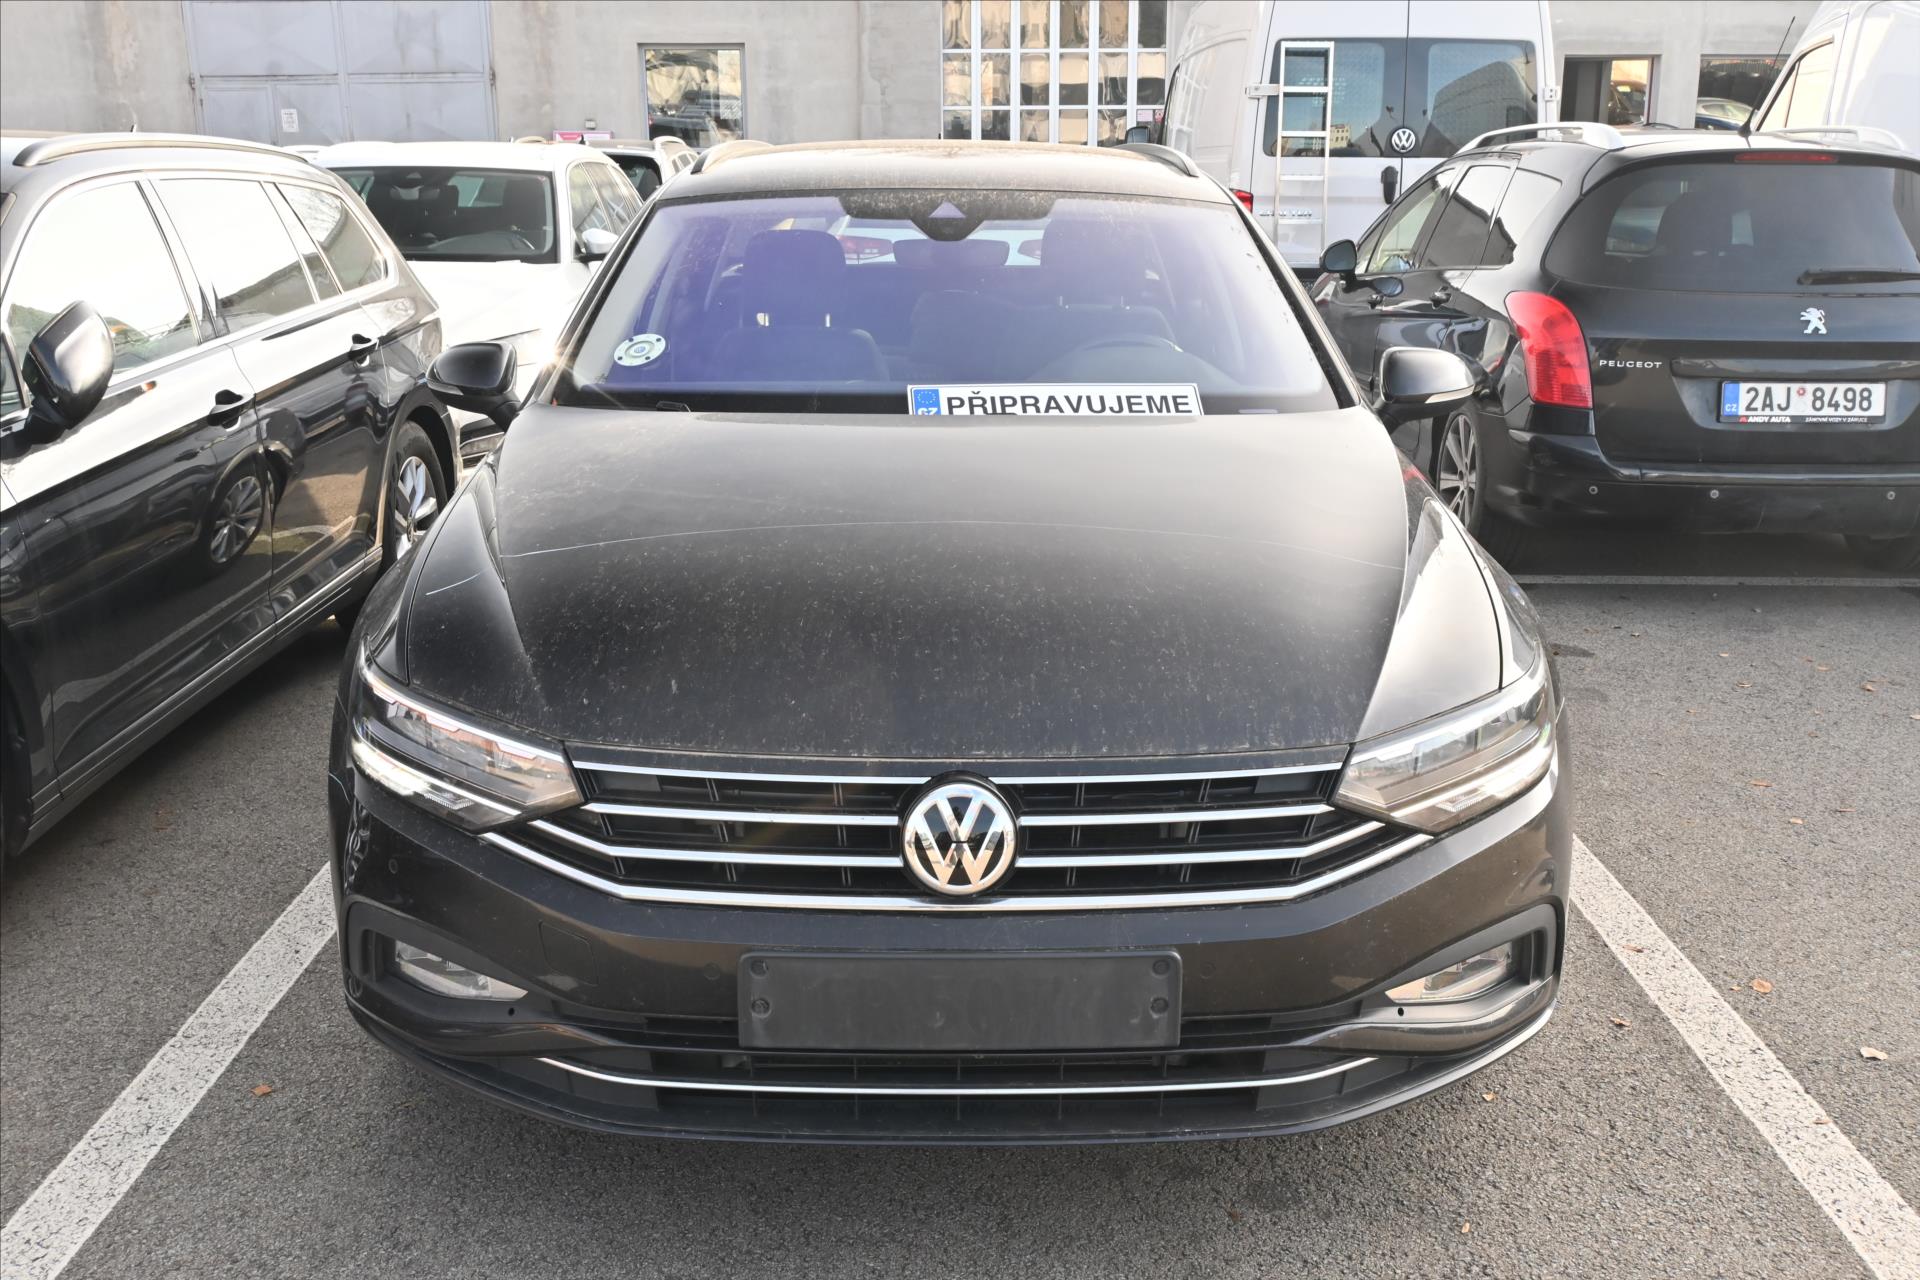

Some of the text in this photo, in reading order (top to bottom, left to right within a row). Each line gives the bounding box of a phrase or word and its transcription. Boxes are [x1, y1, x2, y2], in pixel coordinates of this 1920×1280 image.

[1392, 129, 1415, 152] VW
[1599, 360, 1662, 368] PEUGEOT
[946, 391, 1192, 415] PŘIPRAVUJEME
[1725, 404, 1737, 412] CZ
[1745, 387, 1872, 412] 2AJ 8498
[904, 783, 1016, 895] VW
